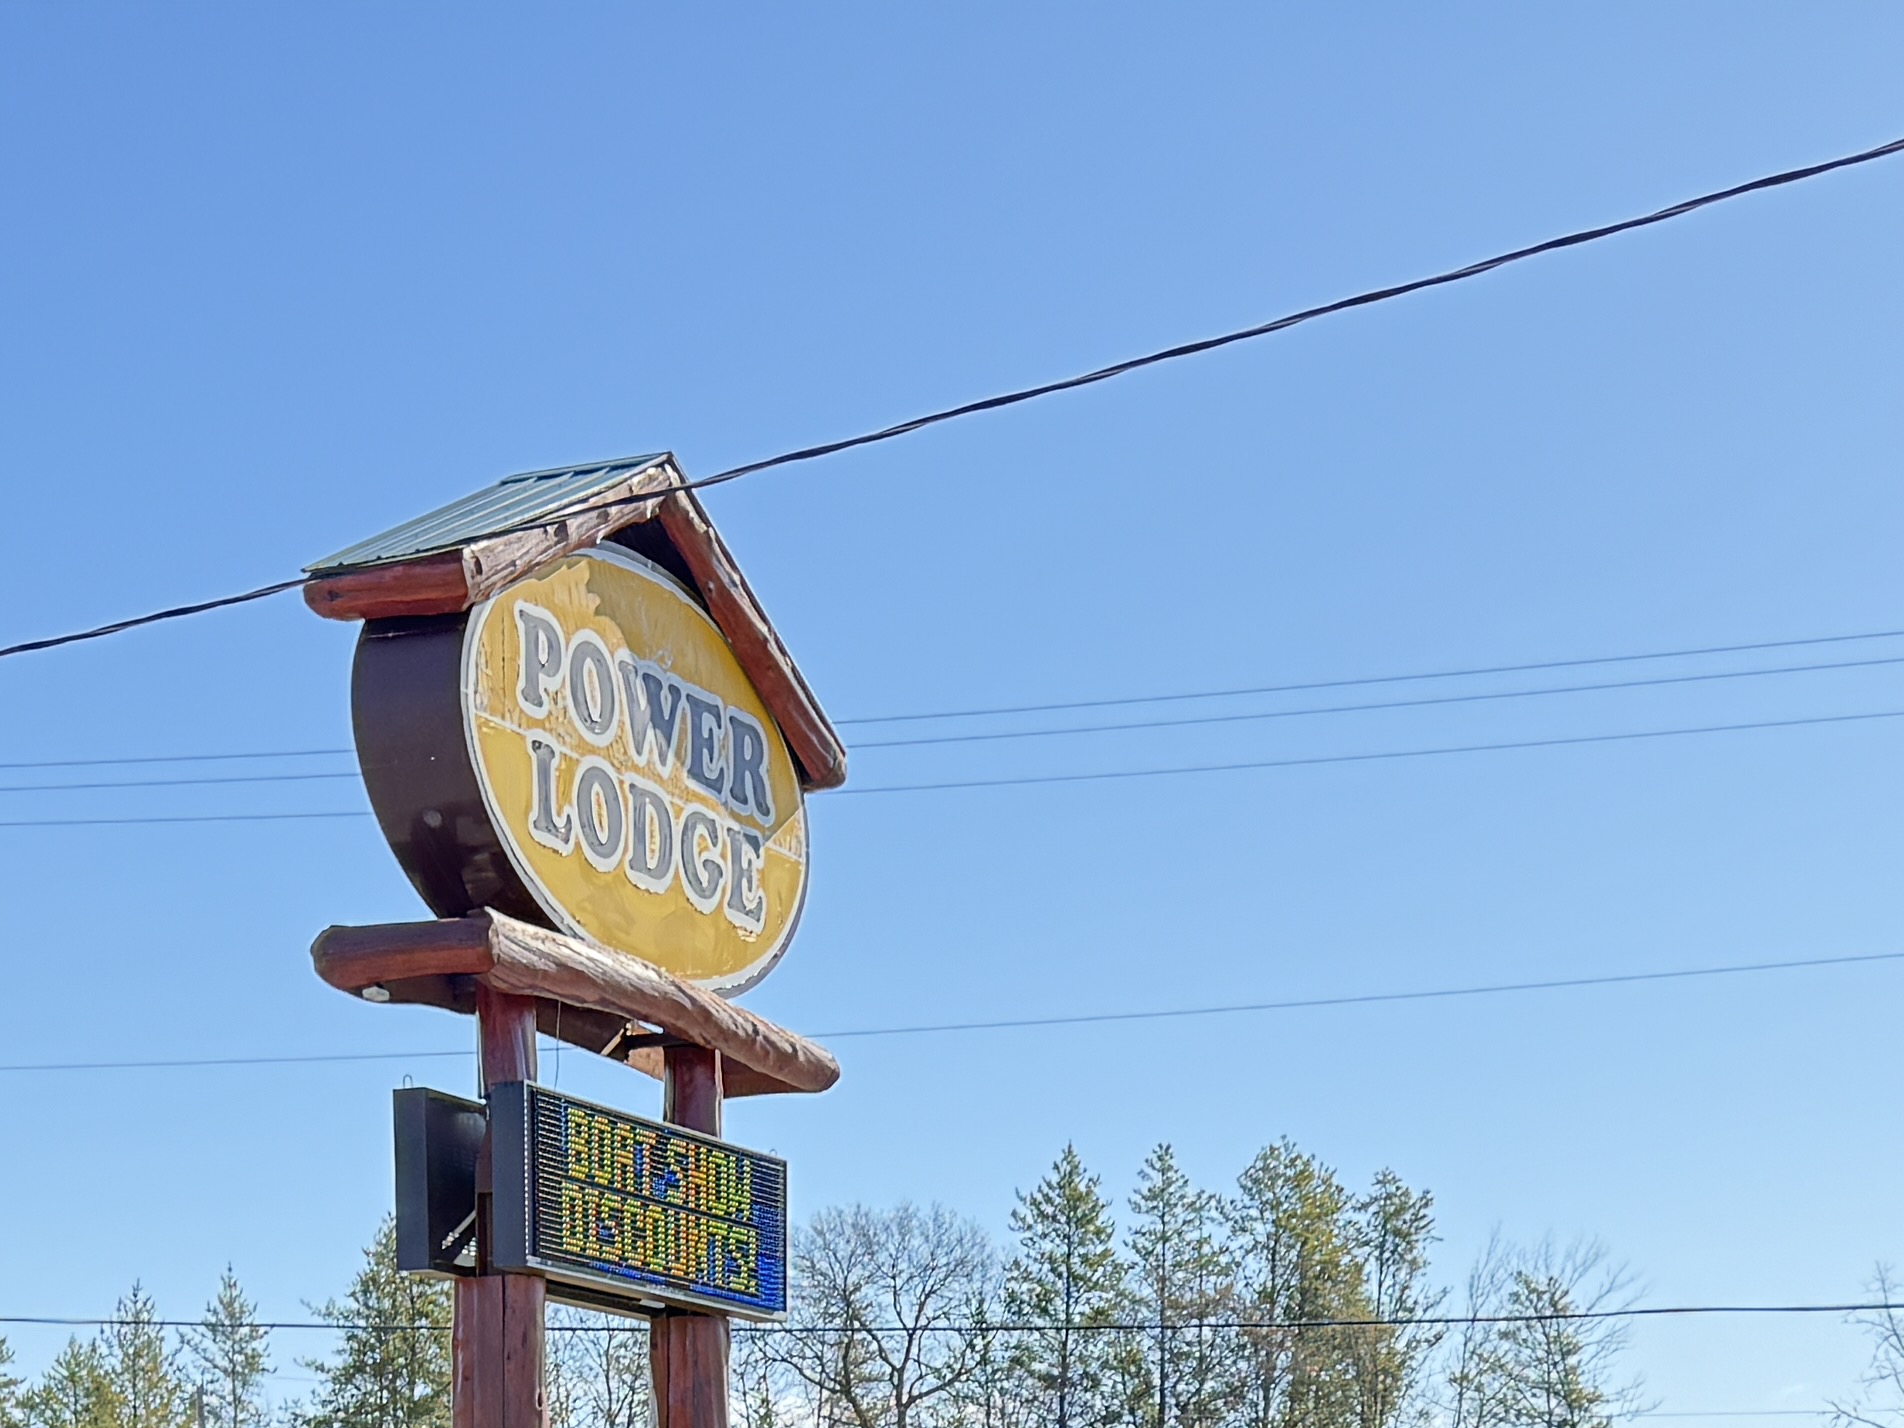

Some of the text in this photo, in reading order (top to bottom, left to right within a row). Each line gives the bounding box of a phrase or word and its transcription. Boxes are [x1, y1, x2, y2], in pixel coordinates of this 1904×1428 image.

[516, 604, 773, 823] POWER
[529, 735, 766, 929] LODGE
[567, 1106, 751, 1222] BOAT SHOW
